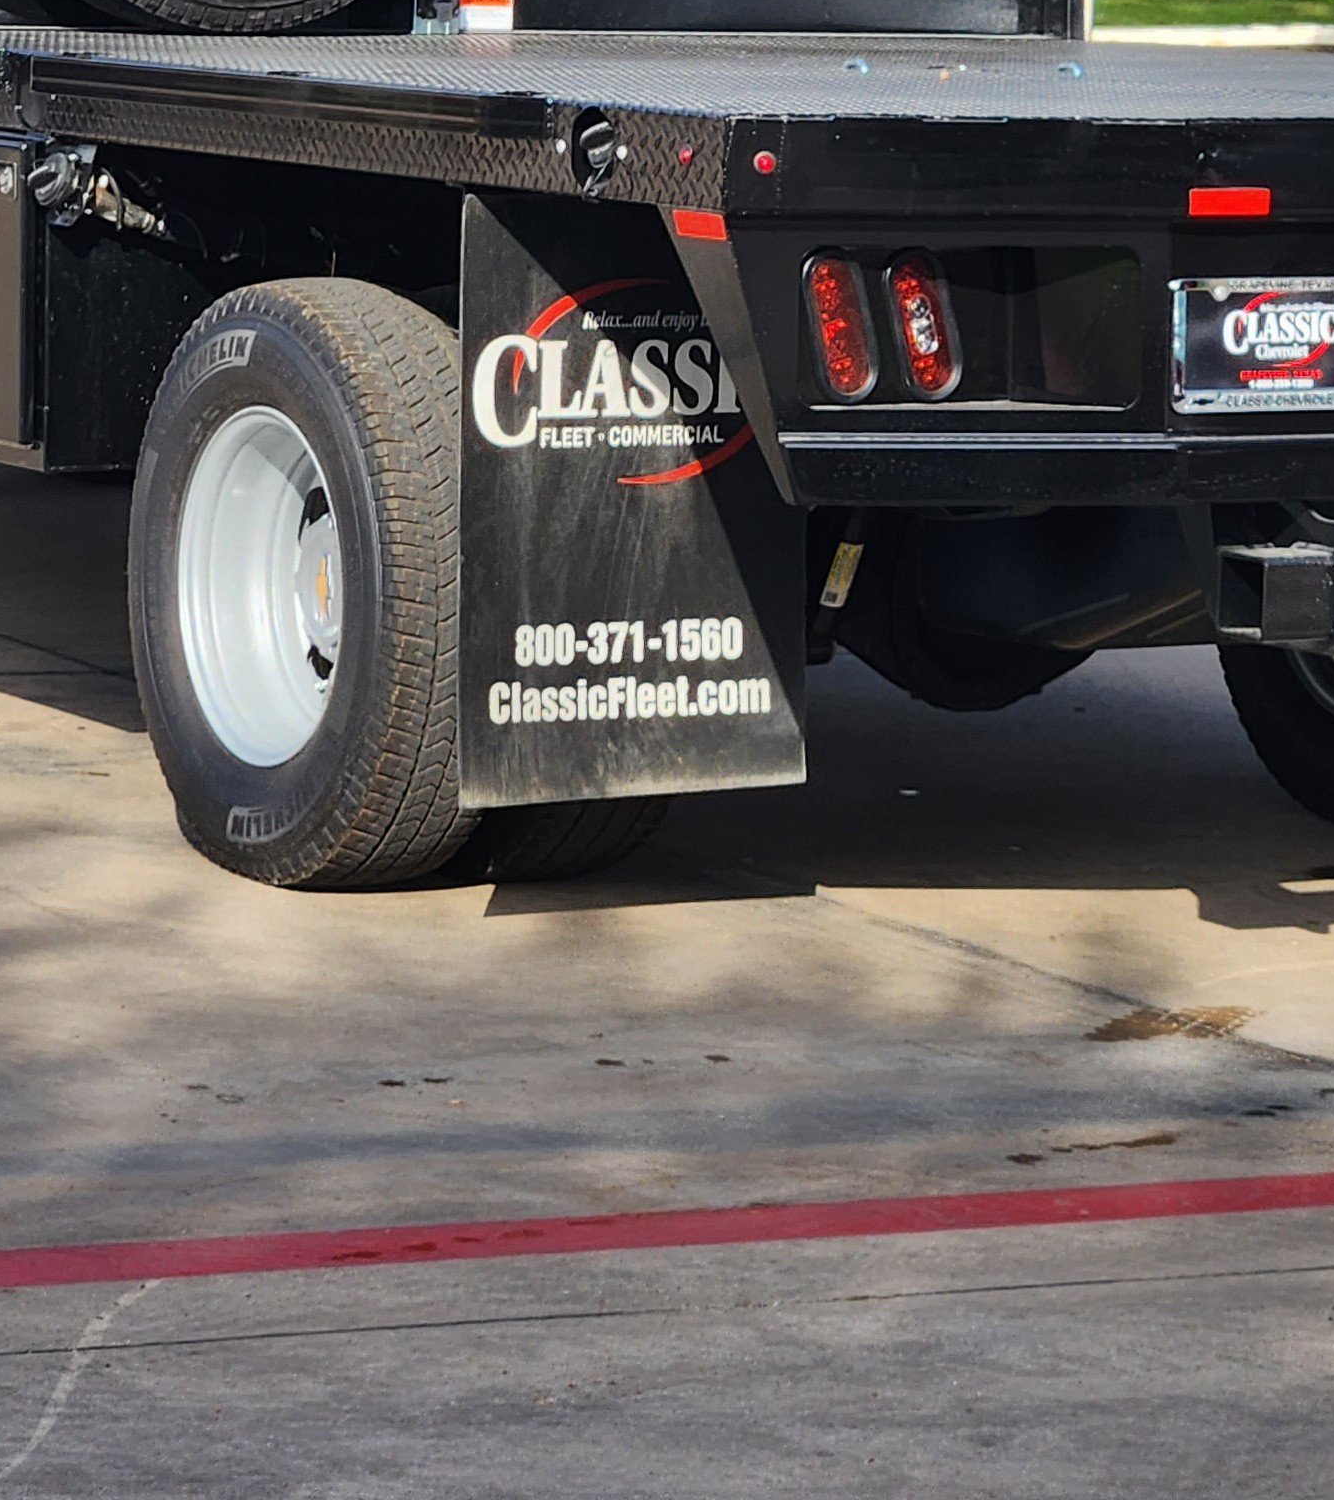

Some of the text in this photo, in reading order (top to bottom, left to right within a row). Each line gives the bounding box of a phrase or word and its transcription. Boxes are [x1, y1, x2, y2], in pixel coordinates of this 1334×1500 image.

[662, 311, 700, 333] enjoy
[1255, 344, 1311, 361] Chevrolet
[539, 425, 725, 449] FLEET COMMERCIAL
[515, 616, 744, 667] 800-371-1560
[488, 674, 771, 724] ClassicFleet.com
